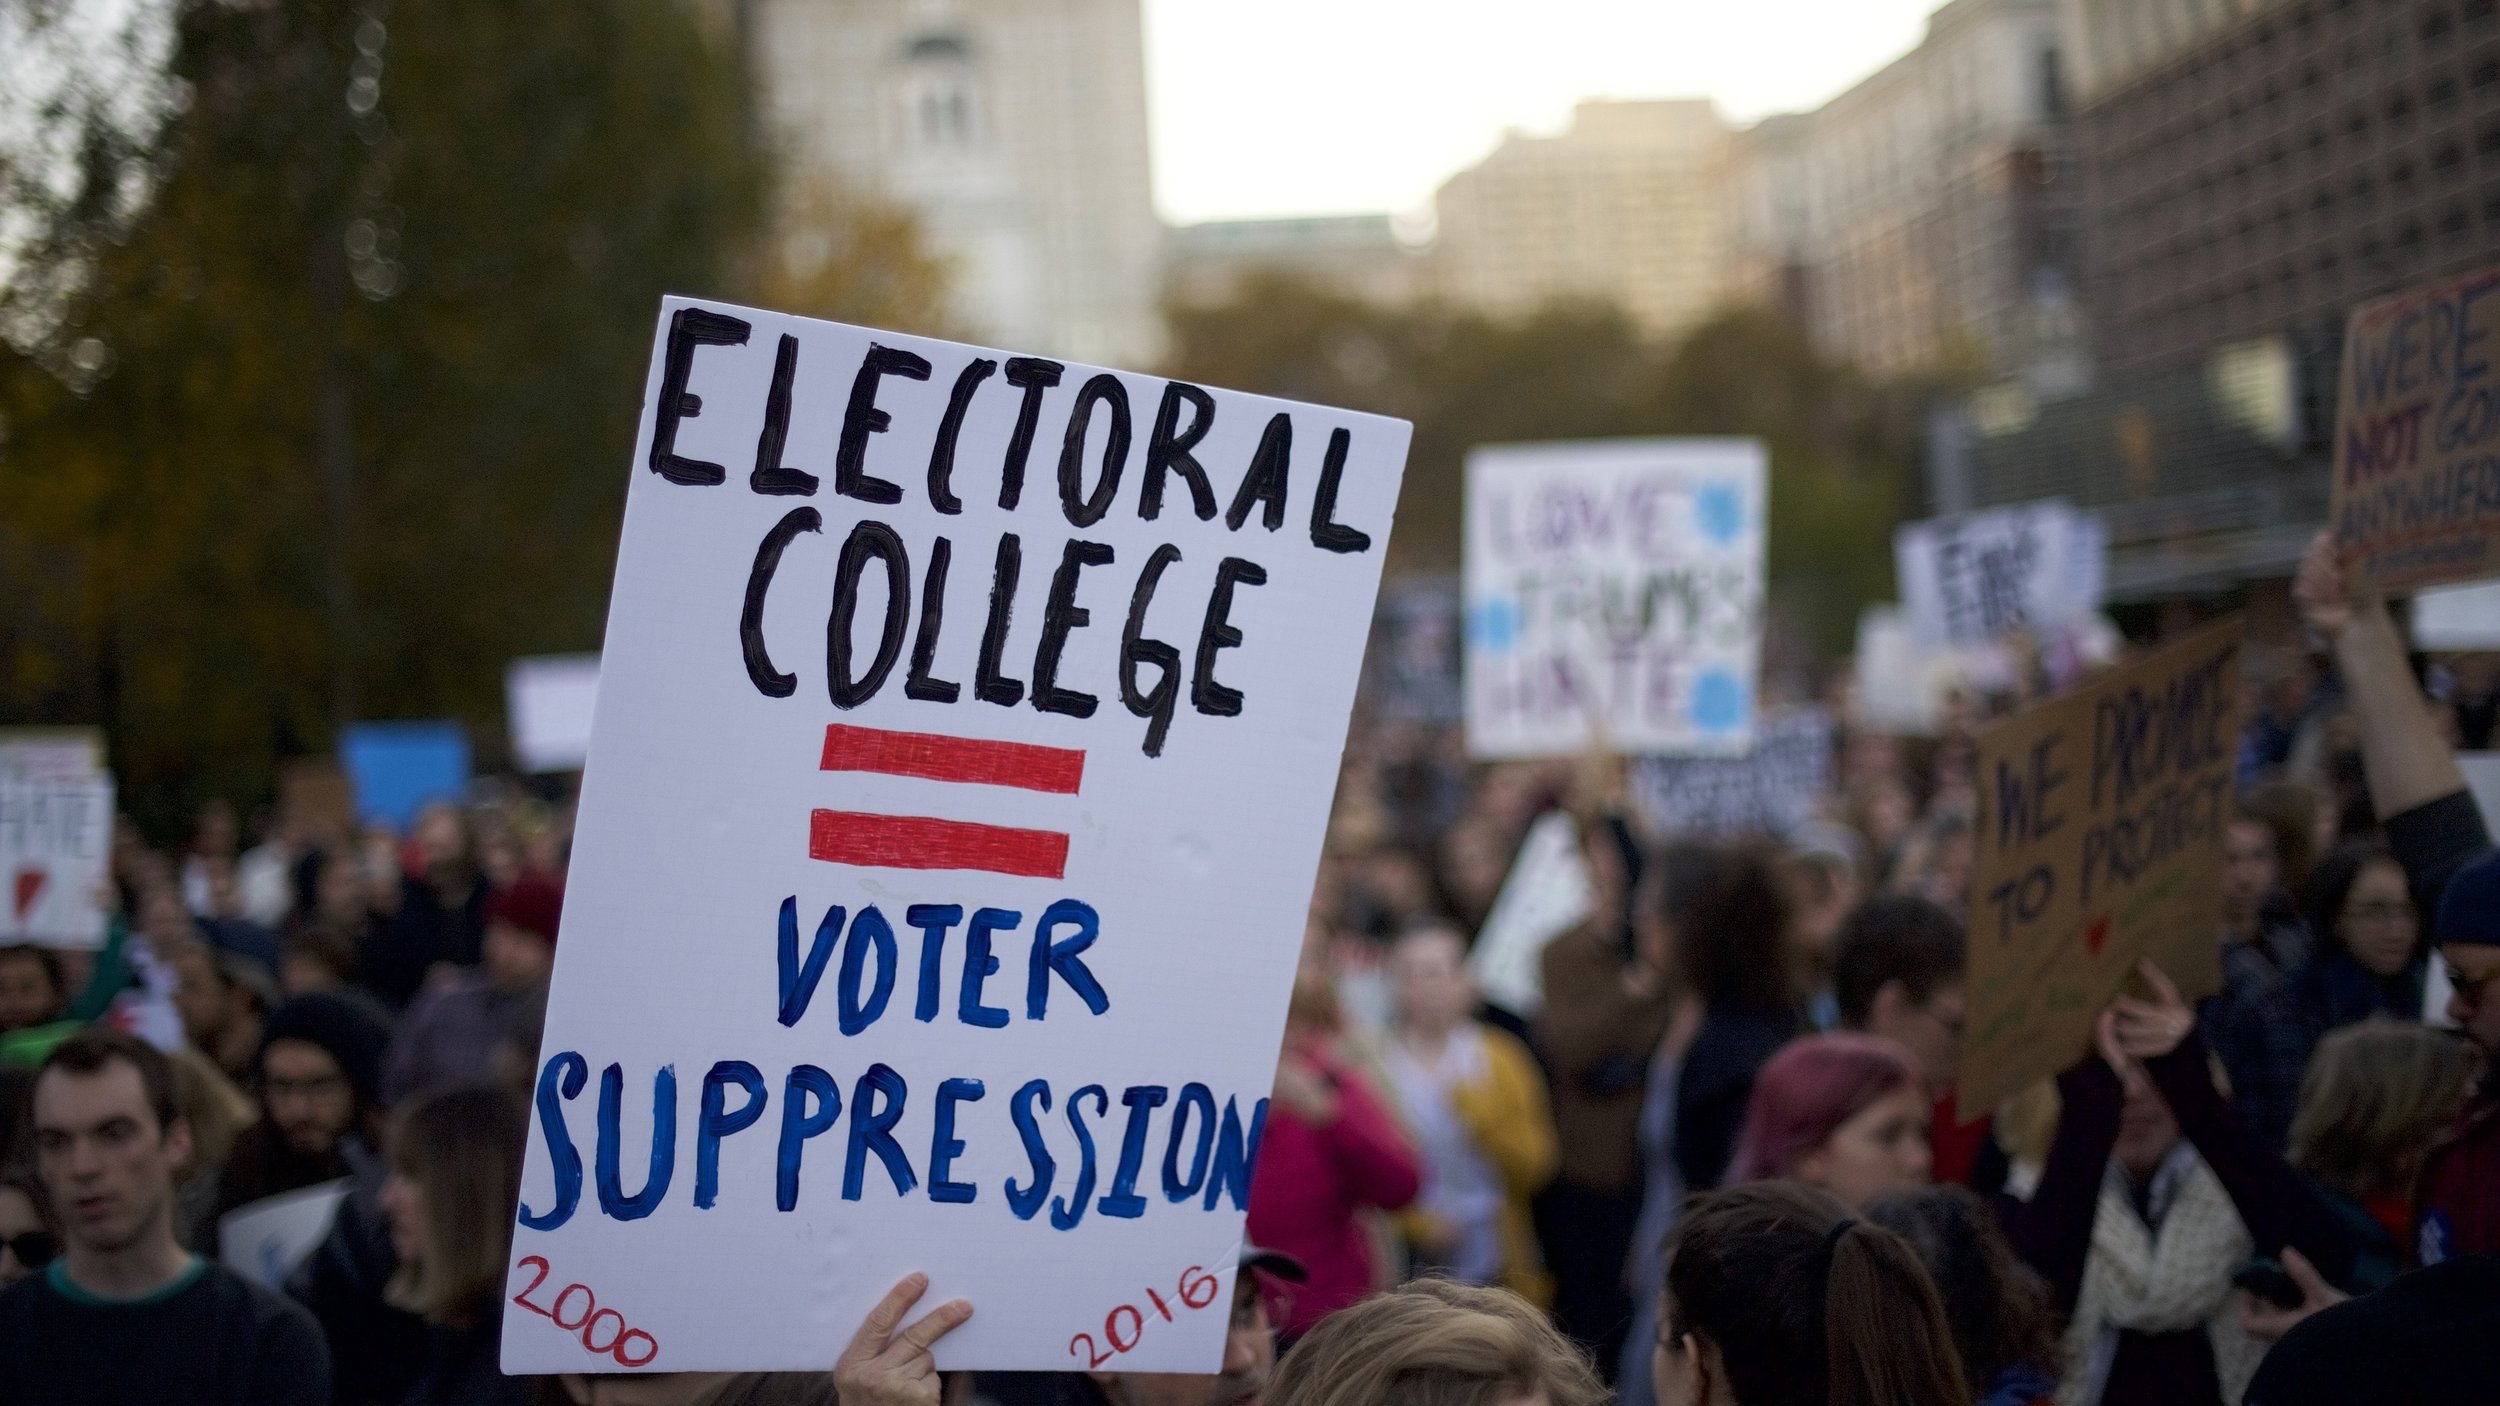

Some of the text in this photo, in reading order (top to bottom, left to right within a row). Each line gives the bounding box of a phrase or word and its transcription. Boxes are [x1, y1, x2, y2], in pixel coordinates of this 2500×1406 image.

[648, 308, 1371, 553] ELECTORAL
[2343, 398, 2431, 490] NOT
[1484, 474, 1698, 562] LOVE
[739, 506, 1268, 758] COLLEGE
[1482, 638, 1694, 730] HATE
[1994, 730, 2069, 855] WE
[1986, 862, 2055, 945] TO
[777, 895, 1110, 1037] VOTER
[518, 1050, 1270, 1232] SUPPRESSION
[512, 1254, 1220, 1370] 2000 2016
